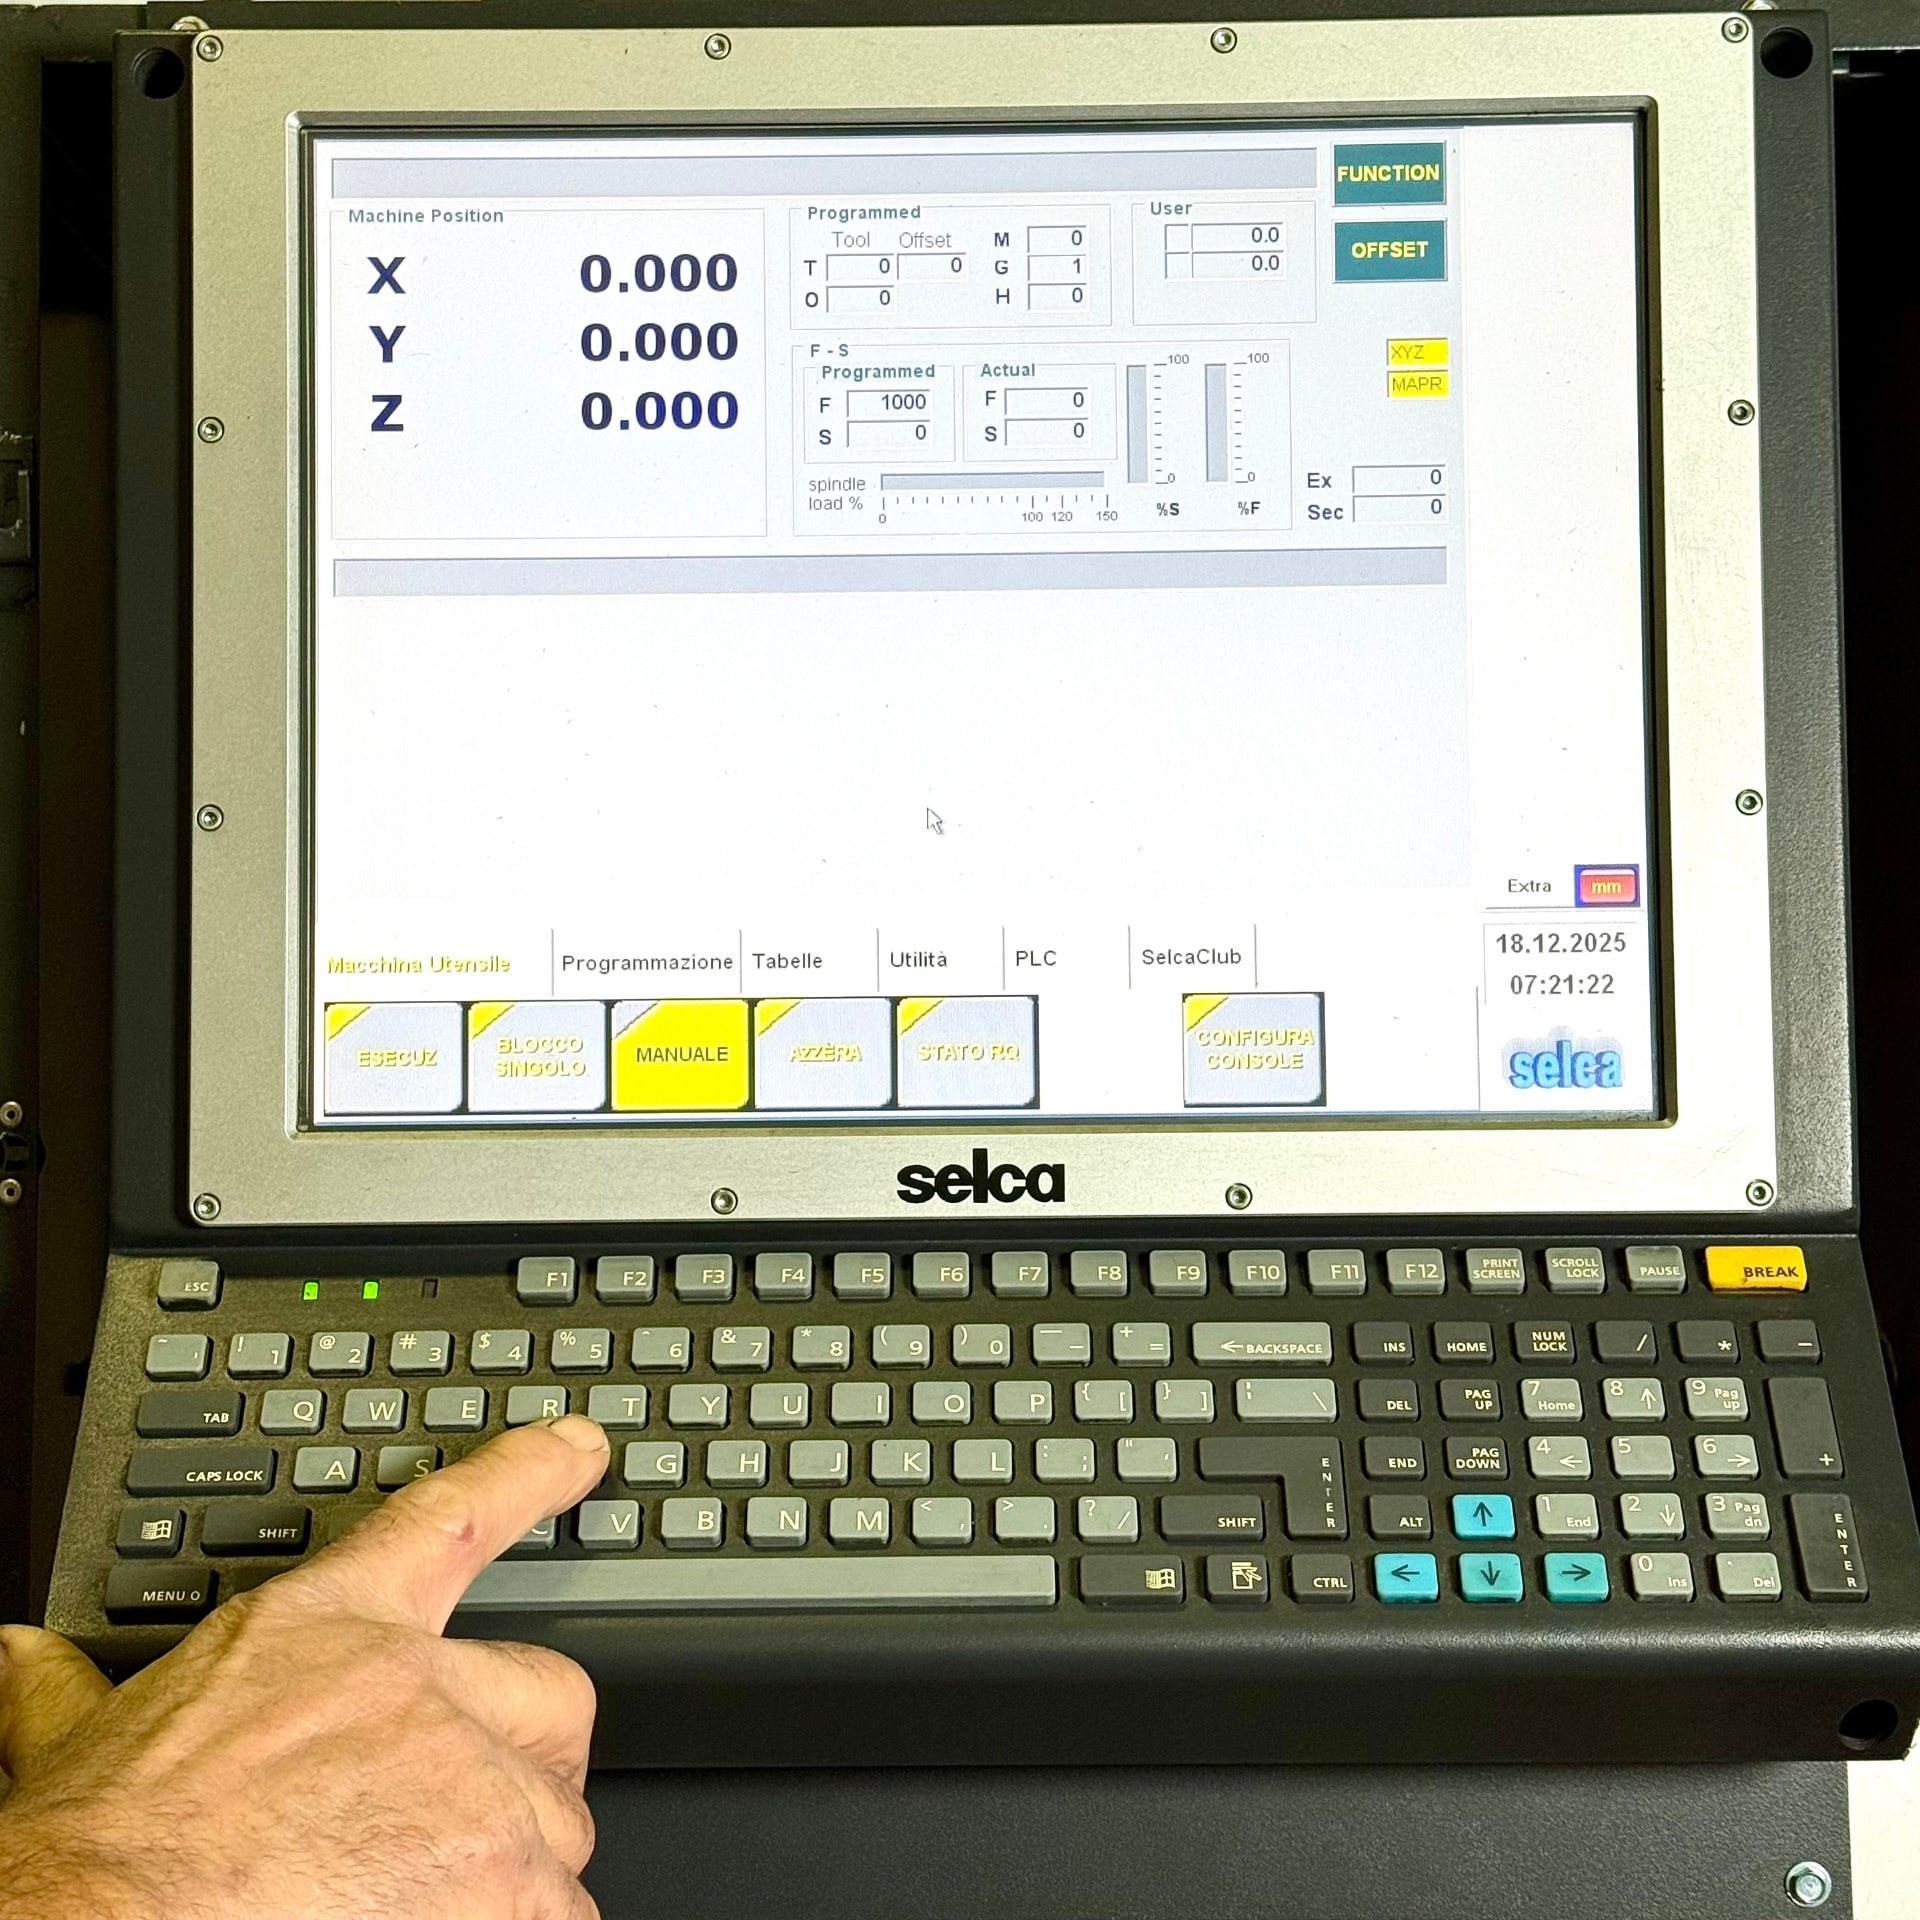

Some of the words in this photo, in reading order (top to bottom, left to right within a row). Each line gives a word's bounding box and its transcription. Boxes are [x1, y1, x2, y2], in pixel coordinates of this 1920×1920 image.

[1337, 164, 1440, 182] FUNCTION
[348, 209, 425, 223] Machine
[431, 208, 504, 223] Position
[808, 206, 921, 222] Programmed
[1150, 202, 1192, 216] User
[832, 232, 870, 248] Tool
[900, 232, 952, 248] Offset
[994, 232, 1010, 247] M
[1072, 230, 1082, 246] 0
[1252, 227, 1280, 243] 0.0
[1352, 240, 1428, 258] OFFSET
[804, 260, 817, 276] T
[879, 258, 890, 274] 0
[951, 257, 962, 273] 0
[994, 260, 1008, 275] G
[1072, 258, 1081, 274] 1
[1252, 255, 1280, 271] 0.0
[368, 256, 406, 294] X
[580, 254, 738, 292] 0.000
[805, 292, 818, 308] O
[879, 290, 890, 305] 0
[996, 288, 1010, 304] H
[1072, 287, 1083, 302] 0
[369, 326, 406, 363] Y
[580, 322, 738, 362] 0.000
[810, 344, 820, 357] F
[838, 344, 848, 357] S
[1168, 354, 1190, 364] 100
[1248, 352, 1270, 364] 100
[1391, 344, 1424, 360] XYZ
[822, 364, 936, 382] Programmed
[980, 364, 1035, 378] Actual
[1392, 377, 1442, 392] MAPR
[820, 397, 831, 414] F
[882, 394, 926, 410] 1000
[986, 390, 996, 406] F
[1073, 392, 1084, 408] 0
[371, 394, 404, 432] Z
[580, 391, 739, 430] 0.000
[819, 429, 832, 445] S
[916, 424, 926, 440] 0
[985, 426, 997, 442] S
[1073, 422, 1084, 438] 0
[809, 477, 866, 494] spindle
[1308, 473, 1332, 488] Ex
[1430, 469, 1442, 485] 0
[809, 496, 843, 510] load
[850, 497, 863, 510] %
[1156, 502, 1180, 516] %S
[1238, 501, 1261, 516] %F
[1308, 504, 1344, 520] Sec
[1431, 499, 1442, 514] 0
[1022, 511, 1044, 522] 100
[1052, 511, 1073, 522] 120
[1096, 511, 1118, 522] 150
[1508, 878, 1552, 892] Extra
[1592, 881, 1622, 894] mm
[1496, 932, 1626, 953] 18.12.2025
[327, 956, 422, 974] Macchina
[430, 954, 510, 973] Utensile
[562, 954, 733, 974] Programmazione
[752, 952, 822, 969] Tabelle
[890, 950, 948, 968] Utilità
[1016, 950, 1056, 967] PLC
[1142, 948, 1242, 965] SelcaClub
[1510, 974, 1614, 994] 07:21:22
[495, 1036, 584, 1054] BLOCCO
[1196, 1028, 1314, 1046] CONFIGURA
[358, 1050, 438, 1068] ESECUZ
[636, 1046, 728, 1062] MANUALE
[917, 1043, 984, 1062] STATO
[991, 1043, 1020, 1062] RQ
[494, 1058, 586, 1077] SINGOLO
[1206, 1053, 1304, 1070] CONSOLE
[1508, 1039, 1622, 1089] selca
[896, 1148, 1066, 1204] selca
[1406, 1264, 1438, 1278] F12
[1482, 1258, 1518, 1268] PRINT
[1551, 1258, 1599, 1268] SCROLL
[1640, 1266, 1681, 1276] PAUSE
[546, 1272, 568, 1288] F1
[623, 1272, 646, 1286] F2
[702, 1270, 725, 1284] F3
[782, 1268, 806, 1283] F4
[860, 1268, 884, 1283] F5
[940, 1268, 964, 1282] F6
[1018, 1266, 1042, 1281] F7
[1098, 1266, 1122, 1280] F8
[1176, 1266, 1200, 1280] F9
[1246, 1265, 1280, 1280] F10
[1330, 1264, 1359, 1280] F11
[1472, 1268, 1520, 1280] SCREEN
[1566, 1268, 1600, 1278] LOCK
[1744, 1266, 1798, 1278] BREAK
[184, 1282, 210, 1292] ESC
[1532, 1331, 1566, 1341] NUM
[1246, 1344, 1322, 1354] BACKSPACE
[1384, 1342, 1406, 1352] INS
[1446, 1342, 1487, 1352] HOME
[1533, 1341, 1568, 1352] LOCK
[1464, 1390, 1492, 1399] PAG
[1528, 1380, 1542, 1396] 7
[1692, 1380, 1706, 1396] 9
[1714, 1388, 1738, 1400] Pag
[368, 1401, 396, 1421] W
[461, 1400, 476, 1419] E
[542, 1398, 559, 1418] R
[622, 1398, 640, 1416] T
[700, 1396, 720, 1415] Y
[783, 1396, 802, 1414] U
[876, 1395, 882, 1414] I
[944, 1394, 965, 1414] O
[1030, 1394, 1045, 1412] P
[1386, 1401, 1412, 1411] DEL
[1474, 1400, 1493, 1410] UP
[1538, 1400, 1576, 1411] Home
[1723, 1400, 1740, 1411] up
[204, 1412, 230, 1424] TAB
[293, 1401, 314, 1422] Q
[1472, 1448, 1499, 1458] PAG
[324, 1460, 346, 1480] A
[414, 1459, 430, 1478] S
[656, 1454, 678, 1474] G
[739, 1452, 760, 1472] H
[829, 1452, 842, 1472] J
[904, 1452, 922, 1472] K
[990, 1452, 1006, 1472] L
[1388, 1458, 1417, 1468] END
[1455, 1458, 1500, 1469] DOWN
[186, 1470, 222, 1482] CAPS
[226, 1470, 264, 1482] LOCK
[1322, 1457, 1336, 1528] ENTER
[1712, 1496, 1726, 1512] 3
[1735, 1502, 1760, 1515] Pag
[610, 1514, 632, 1534] V
[698, 1511, 714, 1530] B
[780, 1510, 800, 1530] N
[856, 1510, 882, 1530] M
[1217, 1517, 1256, 1528] SHIFT
[1400, 1516, 1423, 1528] ALT
[1566, 1516, 1591, 1528] End
[1744, 1515, 1762, 1528] dn
[258, 1528, 298, 1538] SHIFT
[1834, 1513, 1858, 1588] ENTER
[1638, 1556, 1653, 1572] 0
[1313, 1578, 1348, 1588] CTRL
[1668, 1576, 1688, 1588] Ins
[1754, 1576, 1776, 1588] Del
[142, 1590, 187, 1602] MENU
